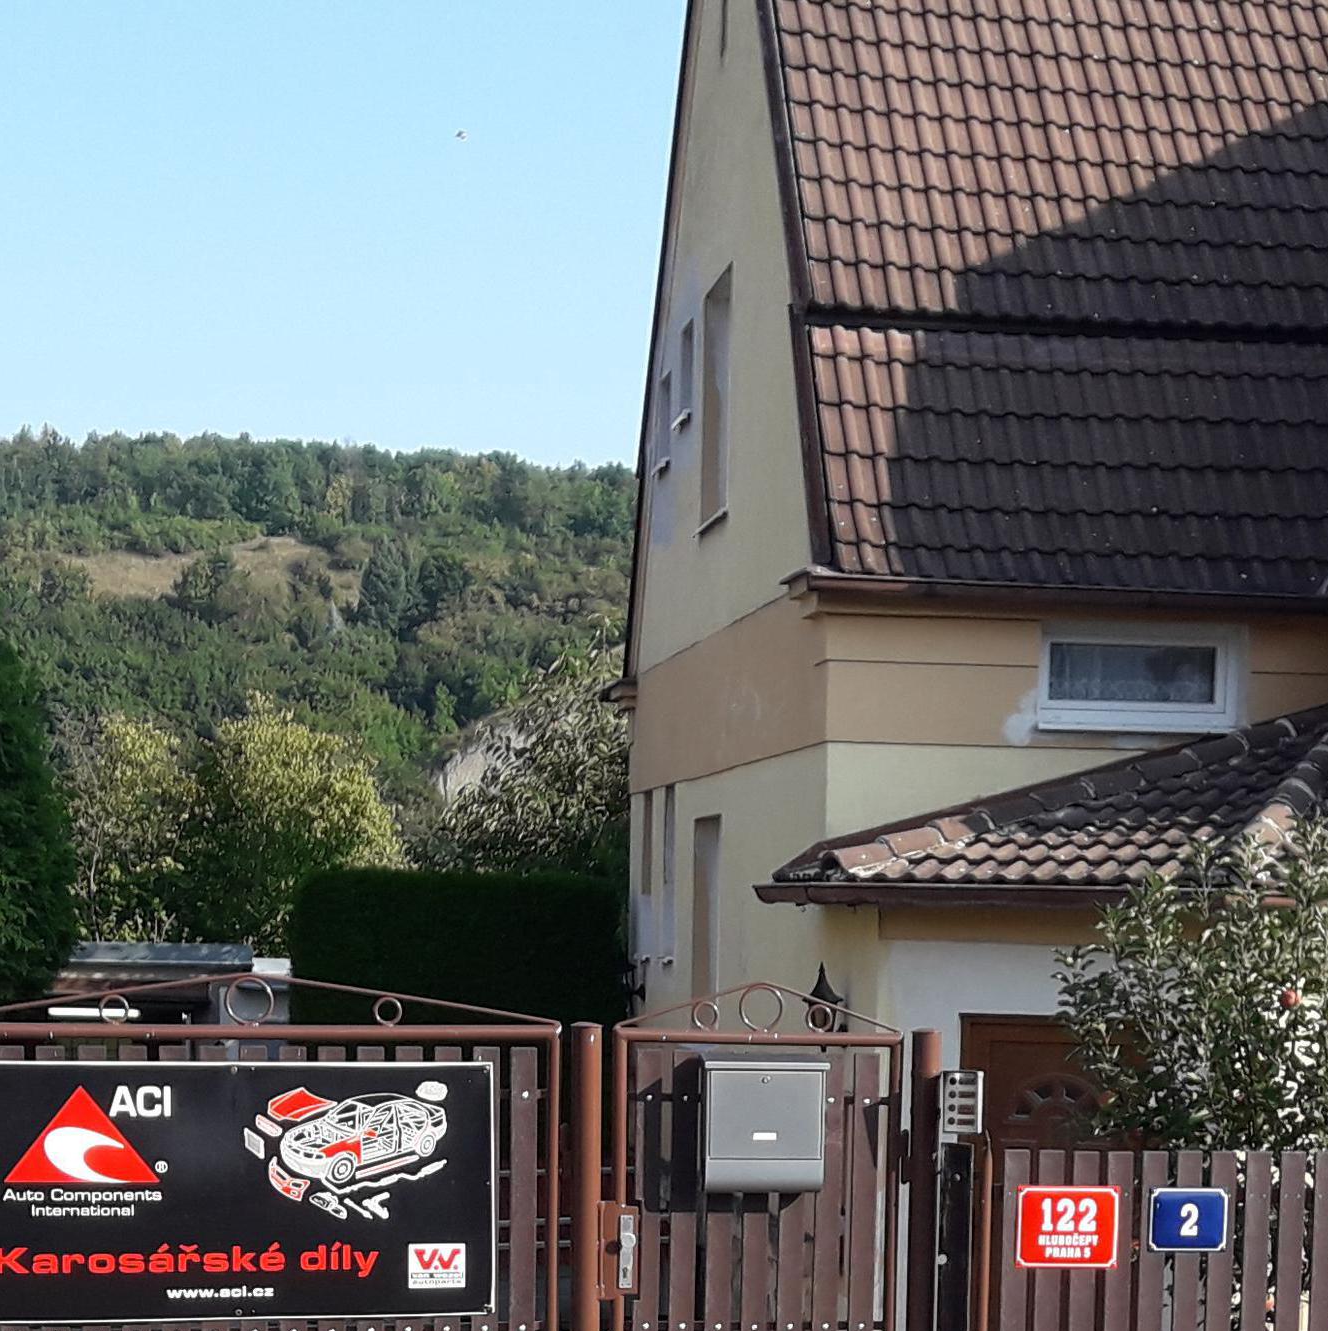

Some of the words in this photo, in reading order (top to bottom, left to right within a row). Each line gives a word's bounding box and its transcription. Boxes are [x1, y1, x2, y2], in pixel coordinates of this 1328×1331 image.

[108, 1085, 172, 1118] ACI
[2, 1188, 45, 1202] Auto
[50, 1188, 163, 1204] Components
[31, 1204, 135, 1217] International
[1040, 1197, 1098, 1233] 122
[1179, 1202, 1200, 1237] 2
[1037, 1232, 1099, 1246] HLUBOČEPY
[299, 1241, 380, 1278] díly
[1045, 1246, 1082, 1258] PRAHA
[1084, 1246, 1091, 1258] 5
[166, 1285, 275, 1299] www.aci.cz
